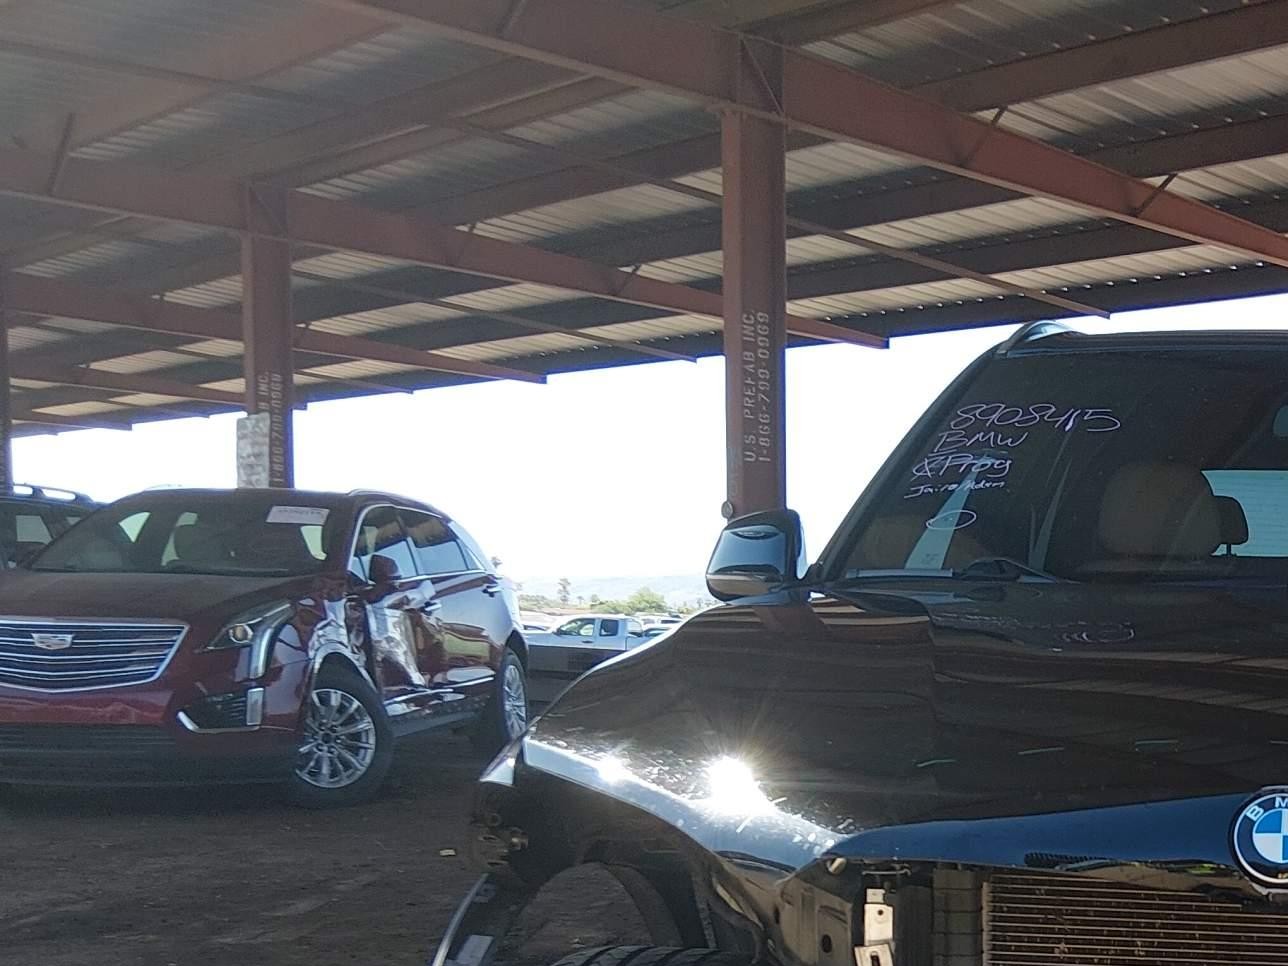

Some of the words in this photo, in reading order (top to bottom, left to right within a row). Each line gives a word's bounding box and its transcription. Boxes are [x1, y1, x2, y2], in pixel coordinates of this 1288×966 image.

[742, 310, 756, 341] INC.
[743, 351, 757, 419] PREFAB
[743, 430, 757, 462] U.S.
[933, 430, 1029, 453] BMW
